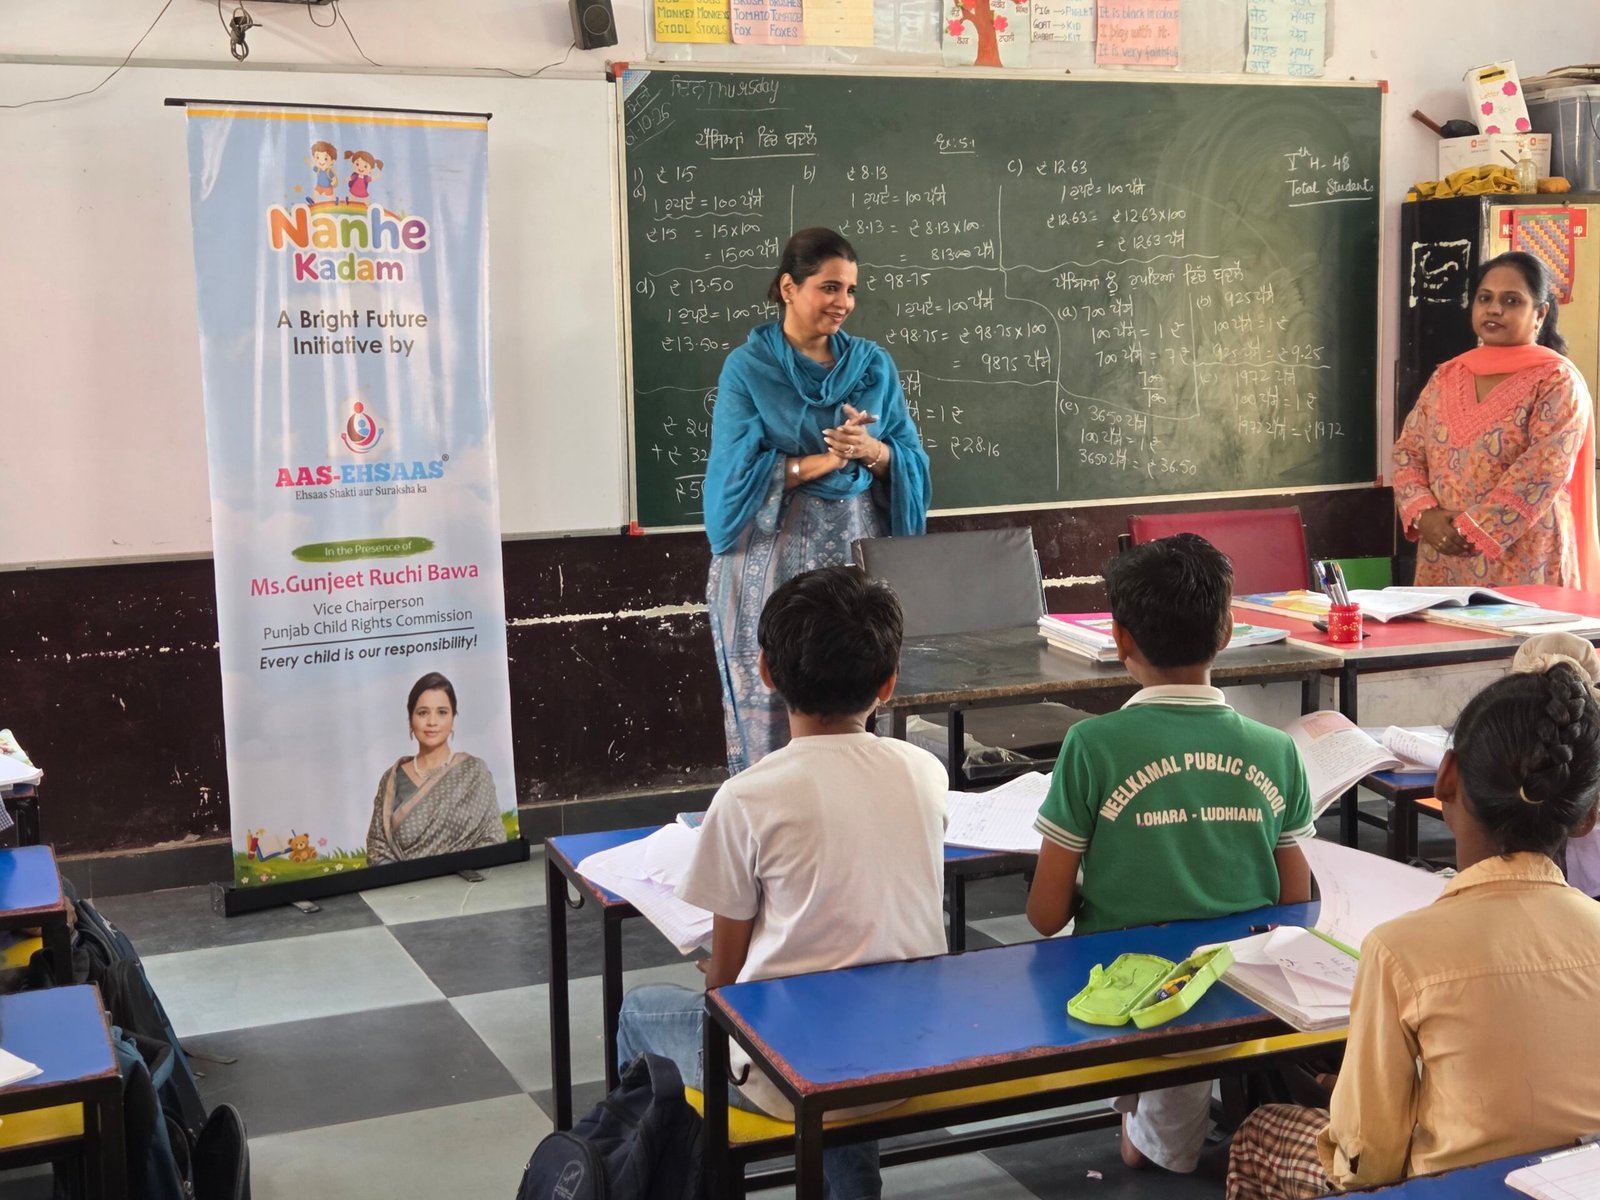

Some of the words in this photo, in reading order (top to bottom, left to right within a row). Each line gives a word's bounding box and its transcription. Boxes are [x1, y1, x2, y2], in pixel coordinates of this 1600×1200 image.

[657, 6, 695, 18] MONKEY
[733, 8, 769, 21] TOMATO
[1034, 3, 1050, 15] PIG
[657, 20, 692, 34] STOOL
[696, 20, 728, 35] STOOLS
[734, 22, 752, 36] FOX
[769, 24, 798, 38] FOXES
[1033, 18, 1052, 30] GOAT
[1066, 20, 1082, 30] KID
[1033, 31, 1055, 41] RABBIT
[1067, 32, 1082, 41] KIT
[707, 77, 780, 104] Thursday
[803, 164, 816, 184] b)
[1284, 179, 1320, 197] Total
[1326, 177, 1374, 196] Students
[714, 195, 737, 211] 100
[270, 207, 427, 250] Nanhe
[720, 246, 755, 263] 1500
[294, 252, 404, 281] Kadam
[635, 277, 656, 300] d)
[726, 306, 750, 322] 100
[947, 298, 968, 314] 100
[1081, 305, 1106, 322] 700
[277, 311, 293, 329] A
[299, 309, 360, 333] Bright
[366, 309, 428, 328] Future
[1091, 326, 1111, 345] 100
[293, 336, 383, 355] Initiative
[389, 335, 415, 358] by
[1095, 350, 1118, 368] 700
[295, 490, 328, 500] Ehsaas
[329, 487, 357, 498] Shakti
[358, 488, 374, 497] aur
[375, 485, 416, 496] Suraksha
[416, 483, 428, 494] ka
[324, 546, 339, 557] In
[339, 545, 354, 556] the
[354, 542, 401, 555] Presence
[402, 540, 413, 551] of
[250, 569, 365, 597] Ms.Gunjeet
[369, 564, 423, 587] Ruchi
[427, 563, 480, 582] Bawa
[312, 600, 343, 616] Vice
[345, 596, 425, 614] Chairperson
[263, 623, 311, 641] Punjab
[313, 618, 348, 636] Child
[351, 615, 393, 634] Rights
[396, 608, 474, 627] Commission
[260, 653, 300, 670] Every
[303, 648, 341, 665] child
[344, 646, 355, 661] is
[358, 646, 382, 659] our
[384, 634, 479, 656] responsibility!
[1099, 755, 1183, 823] NEELKAMAL
[1183, 751, 1245, 776] PUBLIC
[1244, 764, 1288, 819] SCHOOL
[1200, 806, 1264, 823] LUDHIANA
